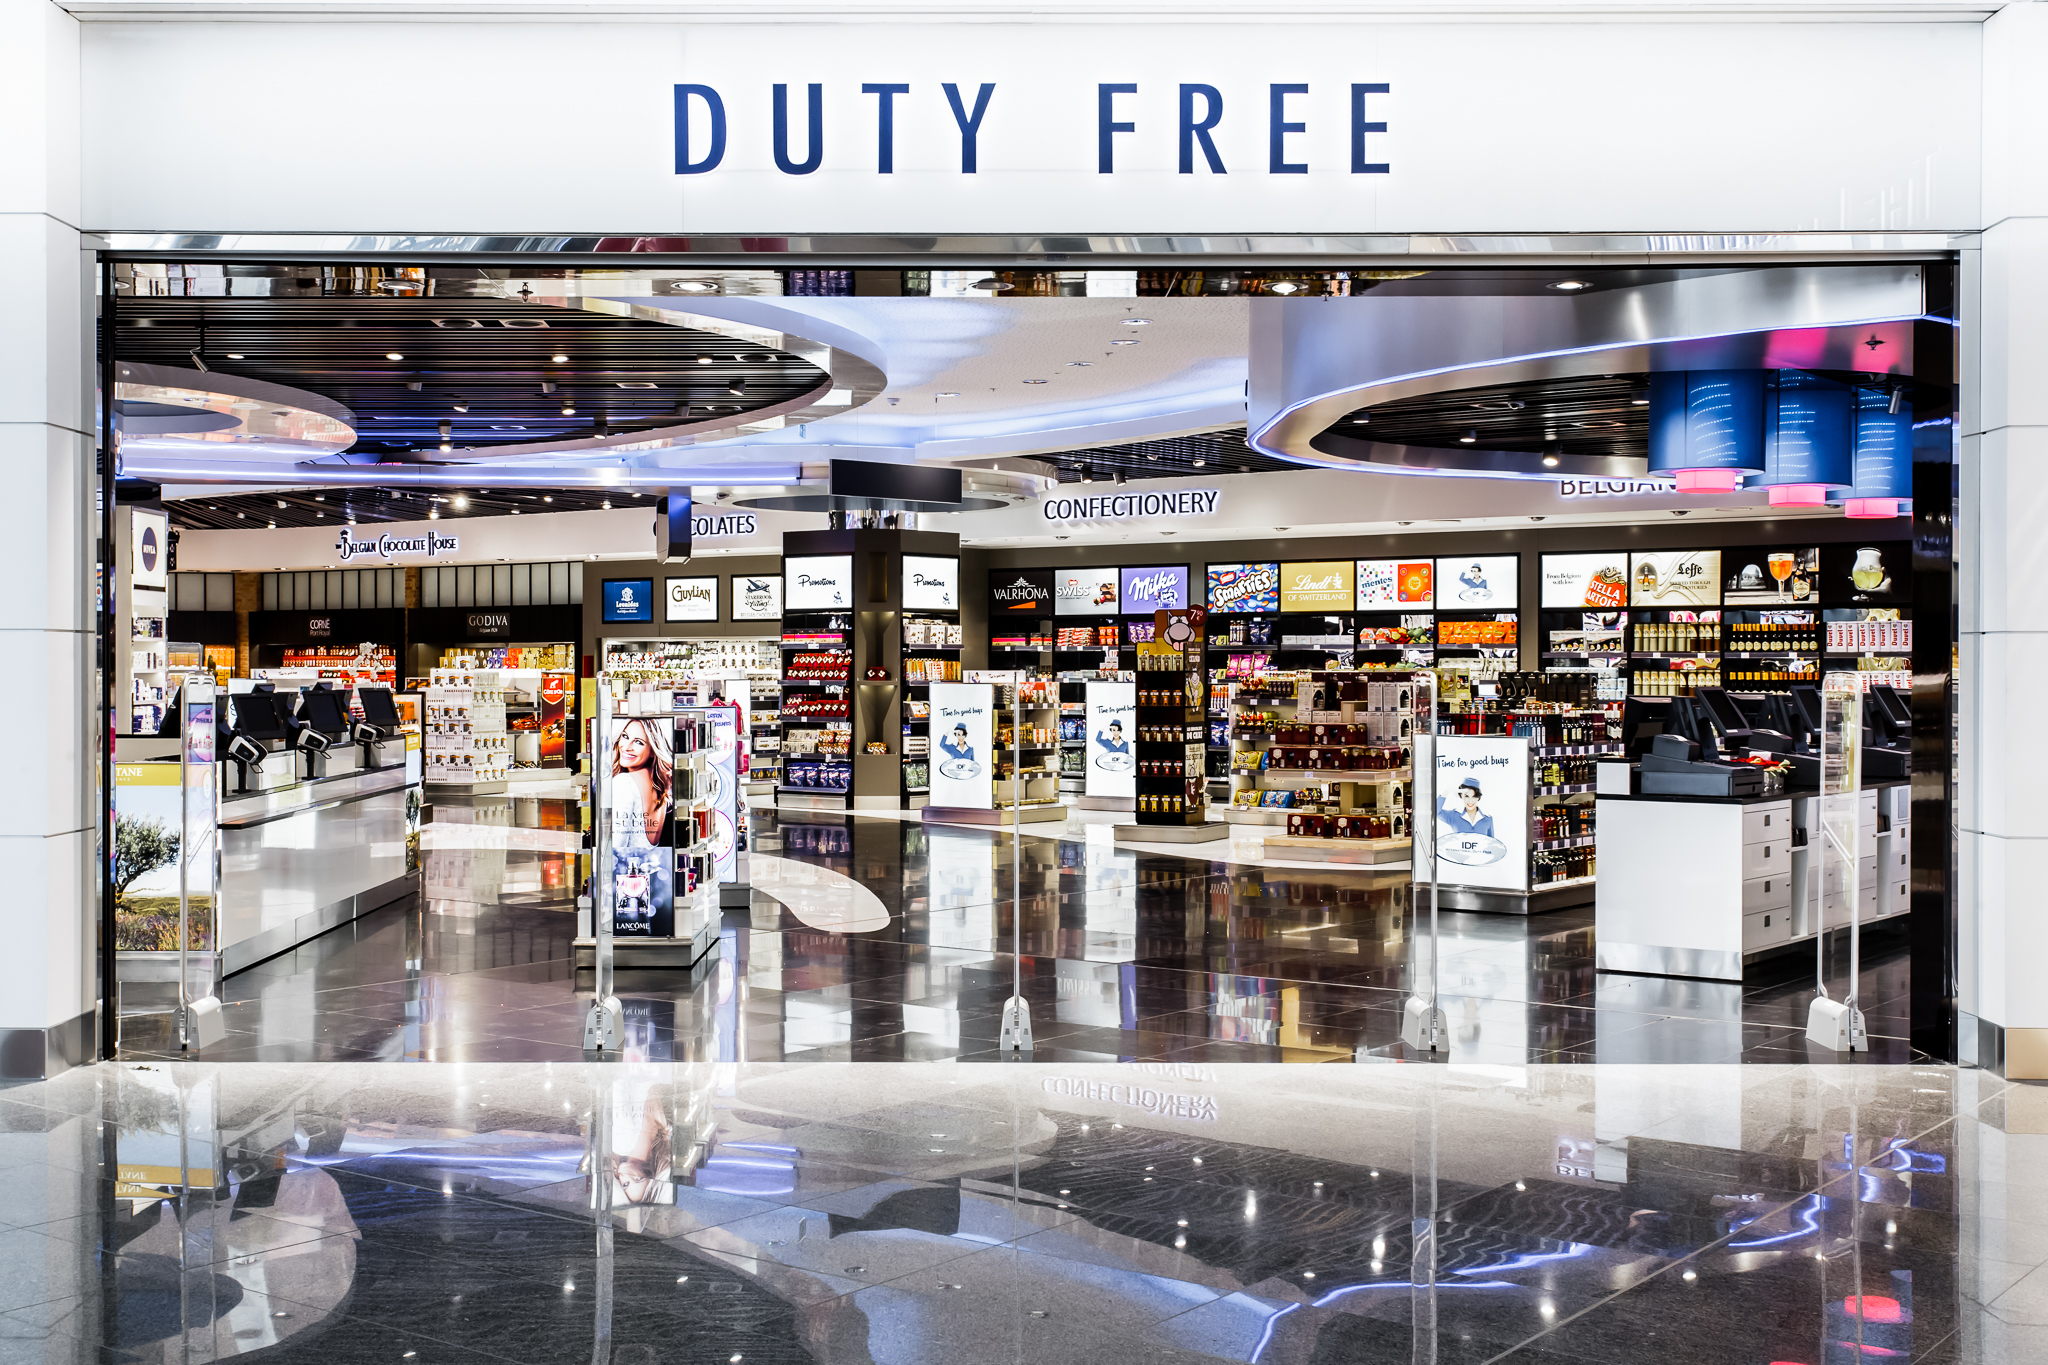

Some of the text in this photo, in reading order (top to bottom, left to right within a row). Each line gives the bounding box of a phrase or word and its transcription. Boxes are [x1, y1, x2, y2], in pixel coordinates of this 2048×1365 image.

[673, 82, 1391, 176] DUTY FREE
[1043, 491, 1218, 520] CONFECTIONERY
[1560, 572, 1582, 580] Belgium
[1676, 562, 1704, 579] Leffe
[797, 574, 837, 588] Promotions
[1128, 570, 1180, 602] Milka
[1292, 573, 1334, 592] Lindt
[1361, 575, 1394, 589] mentos
[993, 587, 1050, 600] VALRHONA
[1056, 586, 1090, 598] SWISS
[1589, 580, 1621, 601] STELLA
[1287, 592, 1347, 602] OF SWITZERLAND
[468, 615, 508, 627] GODIVA
[940, 707, 953, 716] Time
[960, 707, 972, 717] good
[972, 707, 983, 716] buys
[1096, 705, 1108, 714] Time
[1115, 705, 1126, 714] good
[1436, 755, 1509, 769] Time for good buys
[616, 810, 650, 819] La vie
[631, 818, 660, 828] belle
[1461, 841, 1479, 850] IDF
[616, 922, 651, 930] LANCÔME
